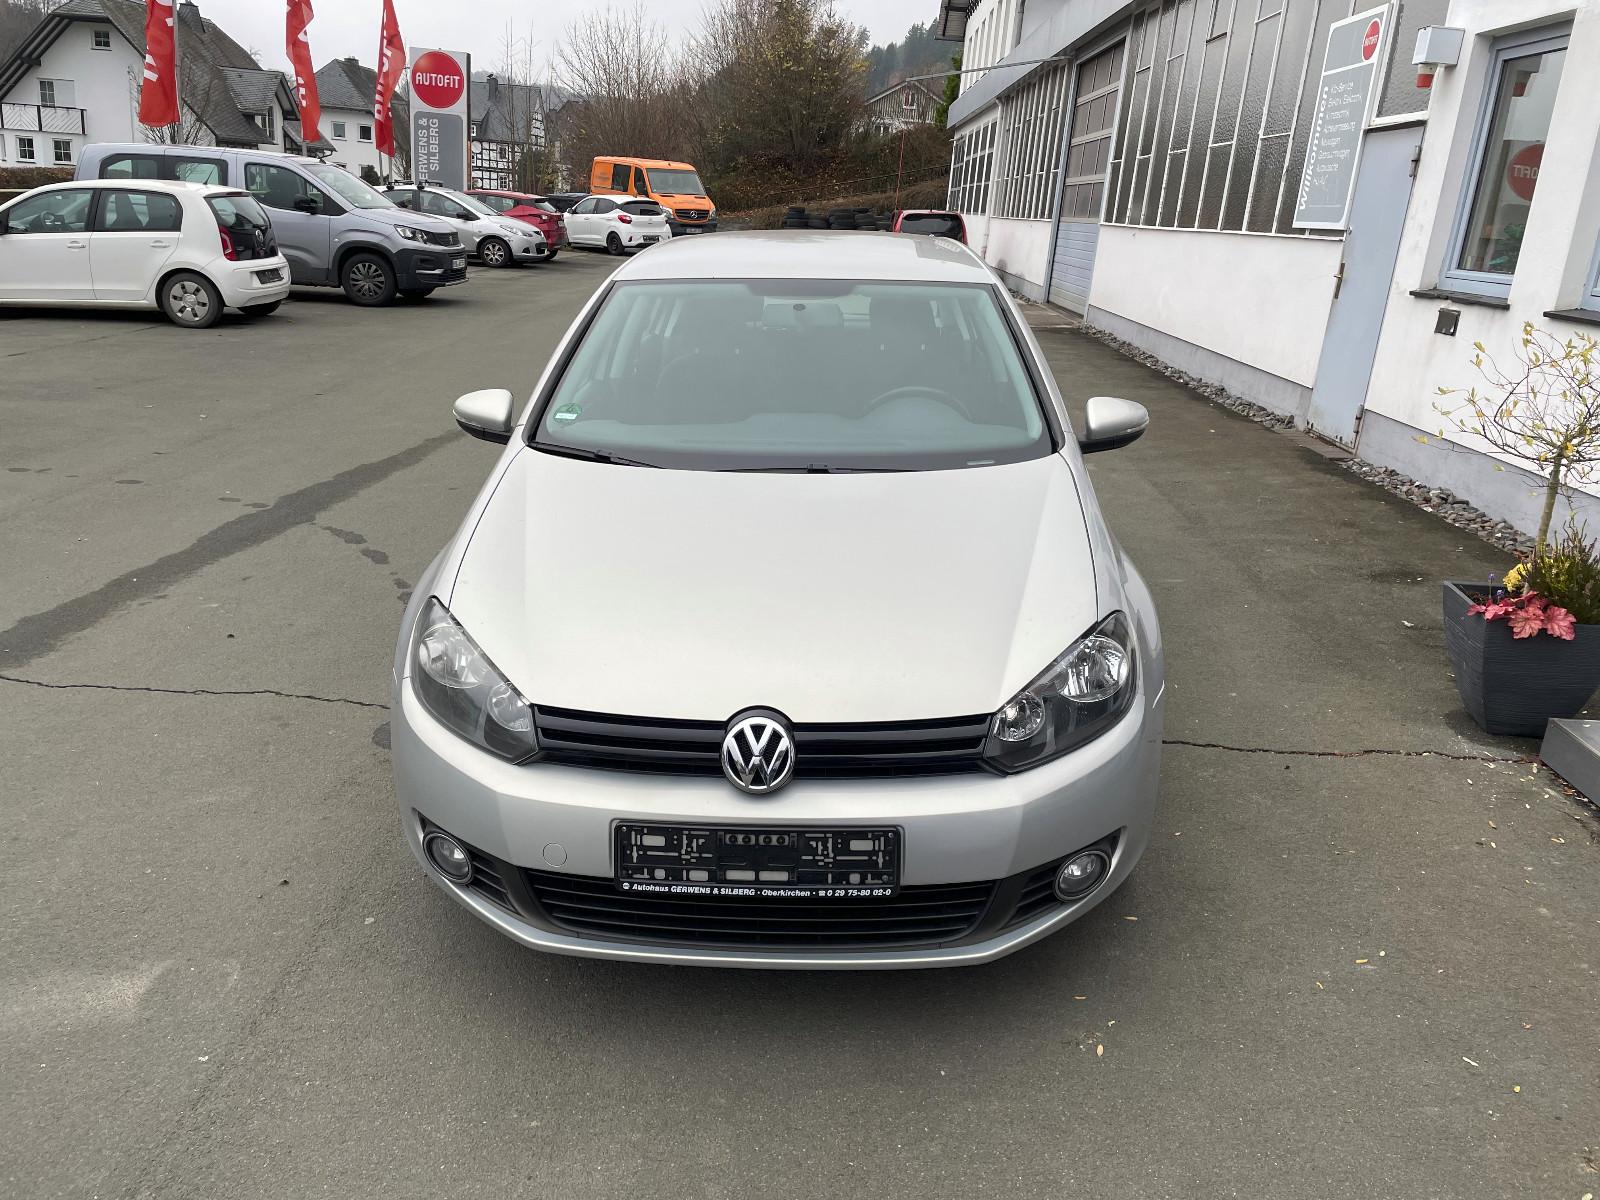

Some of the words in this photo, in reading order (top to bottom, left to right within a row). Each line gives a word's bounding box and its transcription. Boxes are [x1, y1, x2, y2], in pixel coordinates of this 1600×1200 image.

[415, 72, 460, 89] AUTOFIT
[418, 118, 429, 126] &
[429, 118, 440, 171] SILBERG
[632, 883, 669, 892] Autohaus
[671, 886, 711, 895] GERWENS
[712, 887, 720, 895] &
[720, 888, 756, 896] SILBERG
[761, 889, 811, 897] Oberkirchen
[835, 889, 845, 897] 29
[872, 888, 892, 896] 02-0
